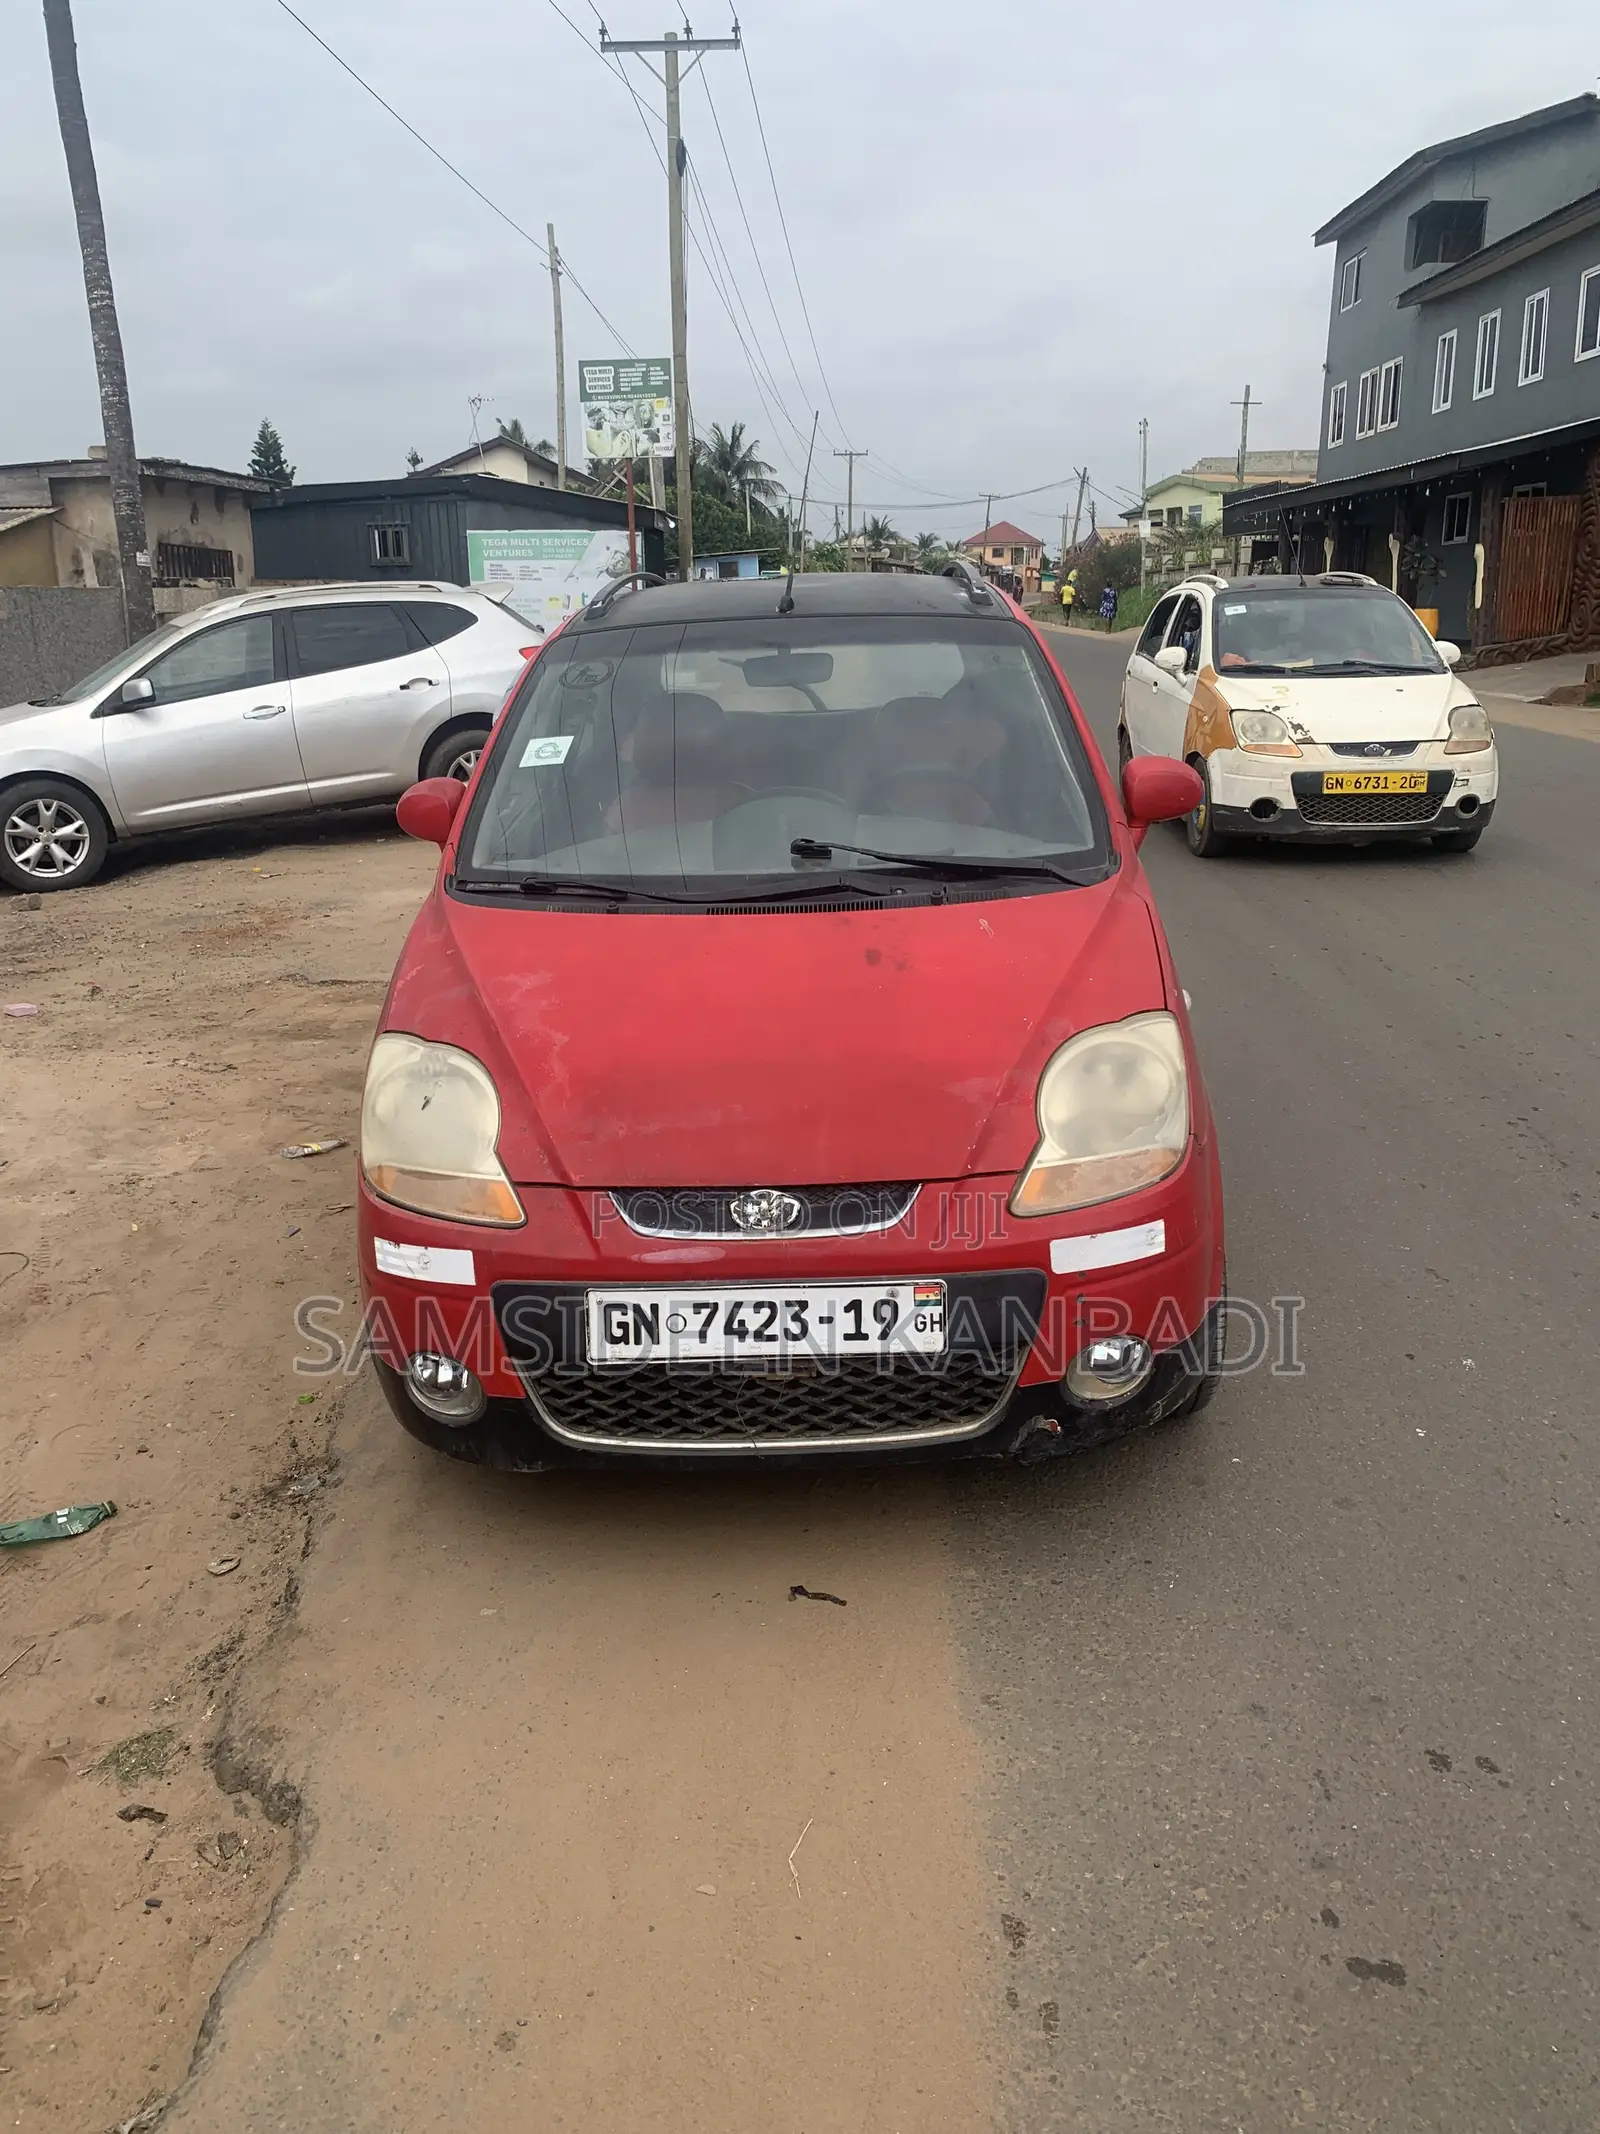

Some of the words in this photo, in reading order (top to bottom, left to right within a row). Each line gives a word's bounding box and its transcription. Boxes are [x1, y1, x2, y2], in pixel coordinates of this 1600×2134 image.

[585, 368, 598, 376] TEGA
[587, 383, 612, 391] VENTURES
[482, 538, 508, 546] TEGA
[510, 538, 539, 546] MULTI
[542, 538, 589, 546] SERVICES
[482, 549, 534, 557] VENTURES
[1325, 776, 1344, 790] GN
[603, 1302, 660, 1346] GN
[692, 1298, 899, 1345] 7423-19
[914, 1312, 943, 1333] GH
